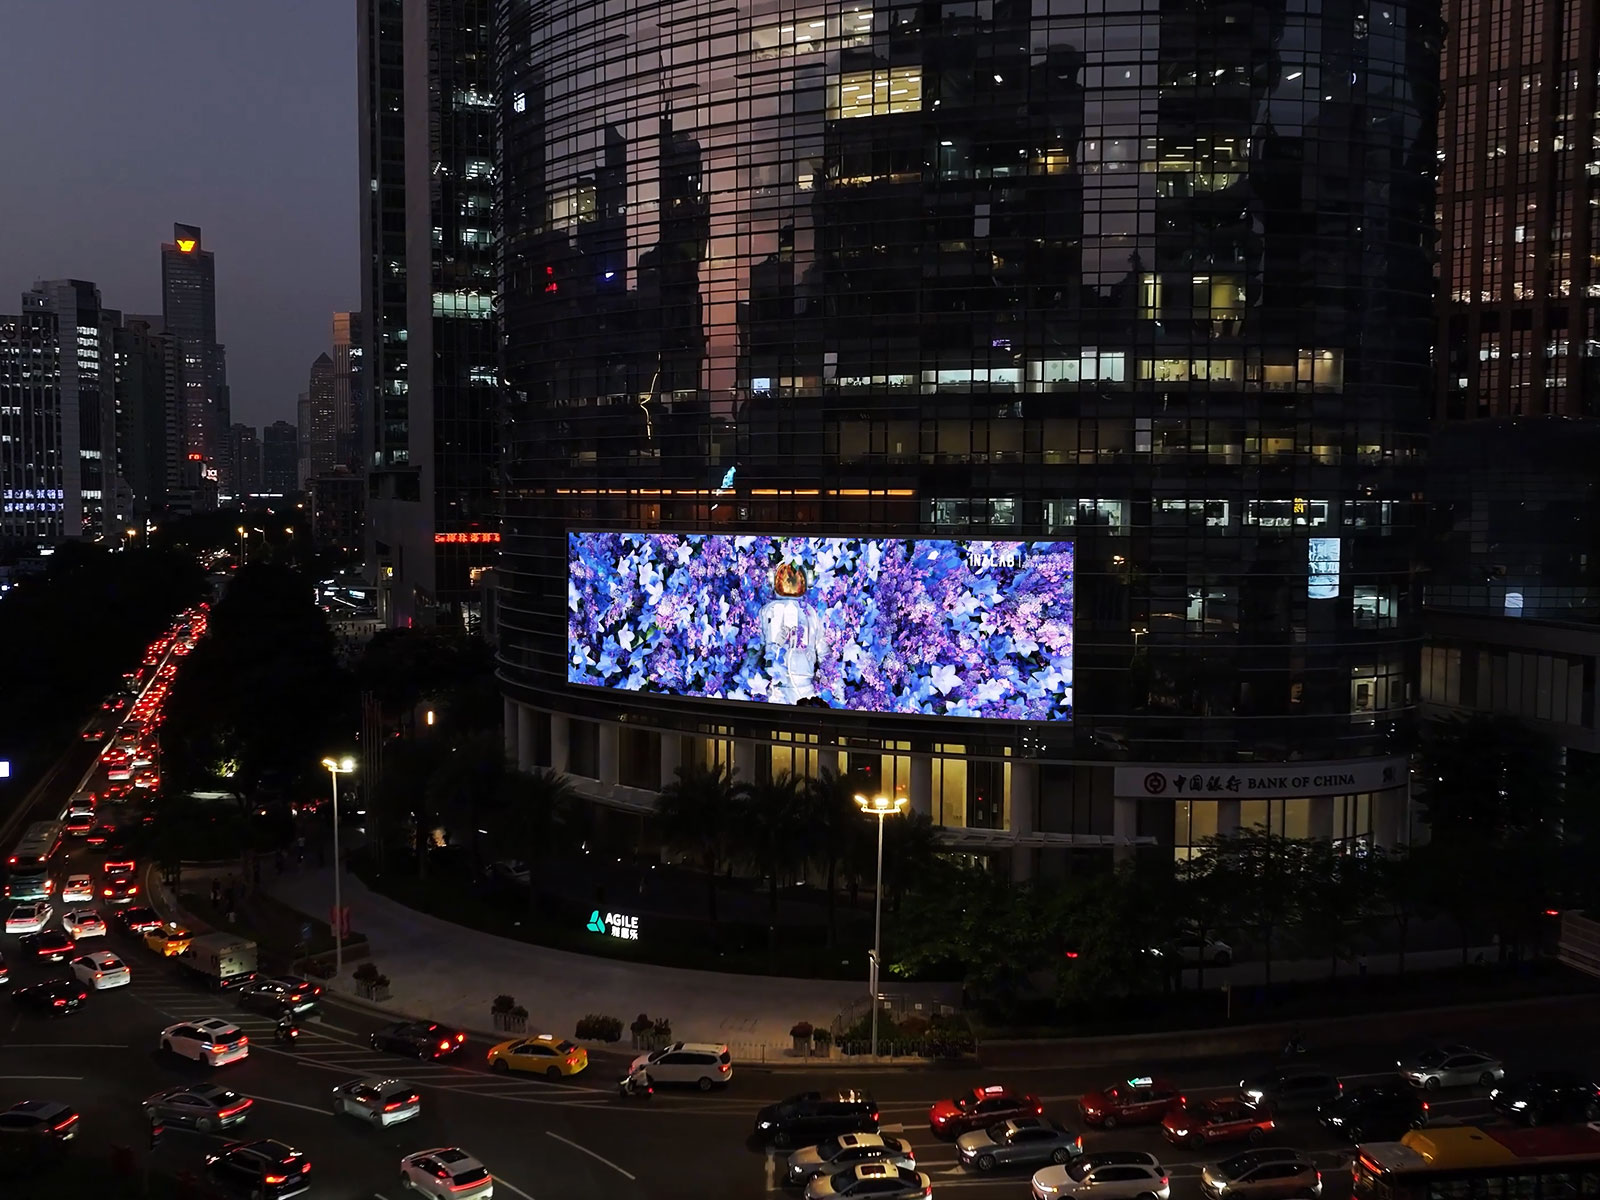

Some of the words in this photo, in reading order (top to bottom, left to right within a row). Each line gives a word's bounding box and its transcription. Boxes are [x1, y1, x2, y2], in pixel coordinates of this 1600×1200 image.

[1173, 774, 1242, 793] 中国银行
[1248, 777, 1287, 789] BANK
[1291, 776, 1310, 788] OF
[1314, 774, 1355, 787] CHINA
[605, 912, 639, 929] AGILE
